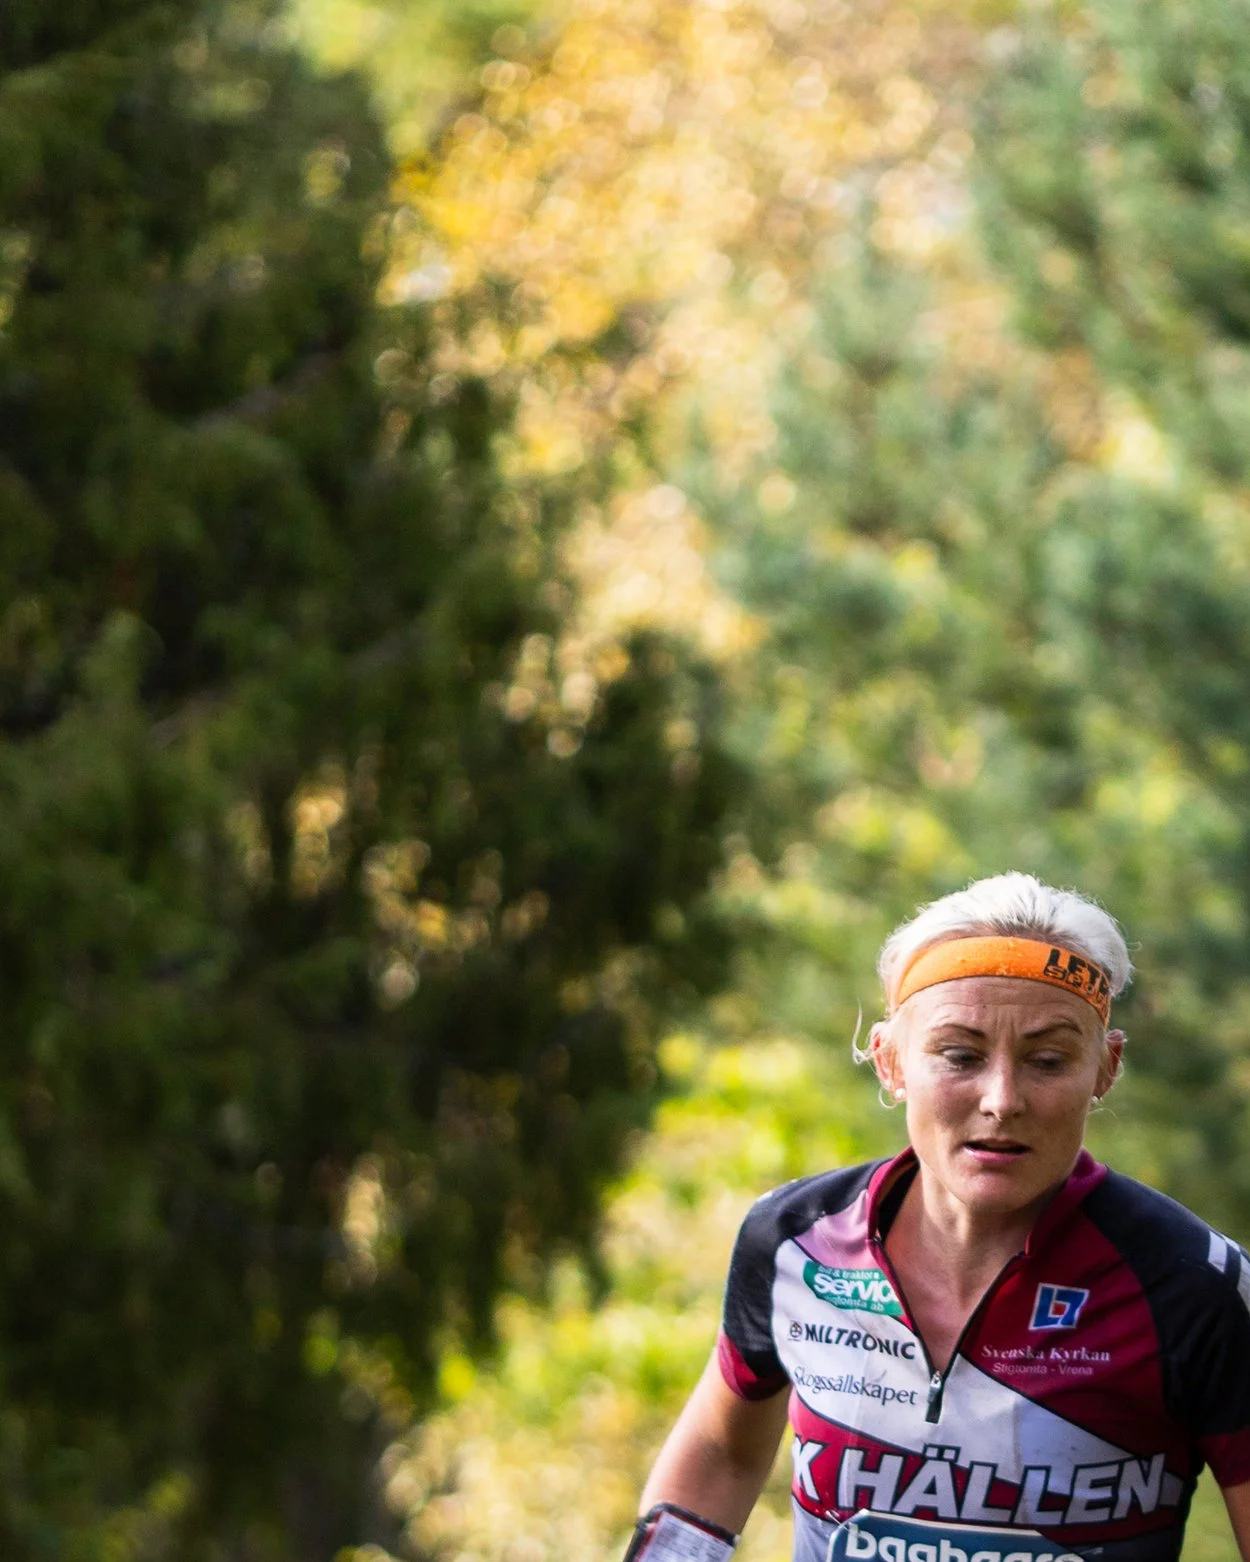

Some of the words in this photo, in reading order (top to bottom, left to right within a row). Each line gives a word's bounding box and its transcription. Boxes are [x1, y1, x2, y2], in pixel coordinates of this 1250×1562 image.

[804, 1322, 917, 1360] MILTRONIC
[982, 1344, 1045, 1360] Svenska
[1049, 1346, 1112, 1364] Kyrkan
[794, 1366, 919, 1406] Skogssällskapet
[837, 1443, 1166, 1526] HÄLLEN
